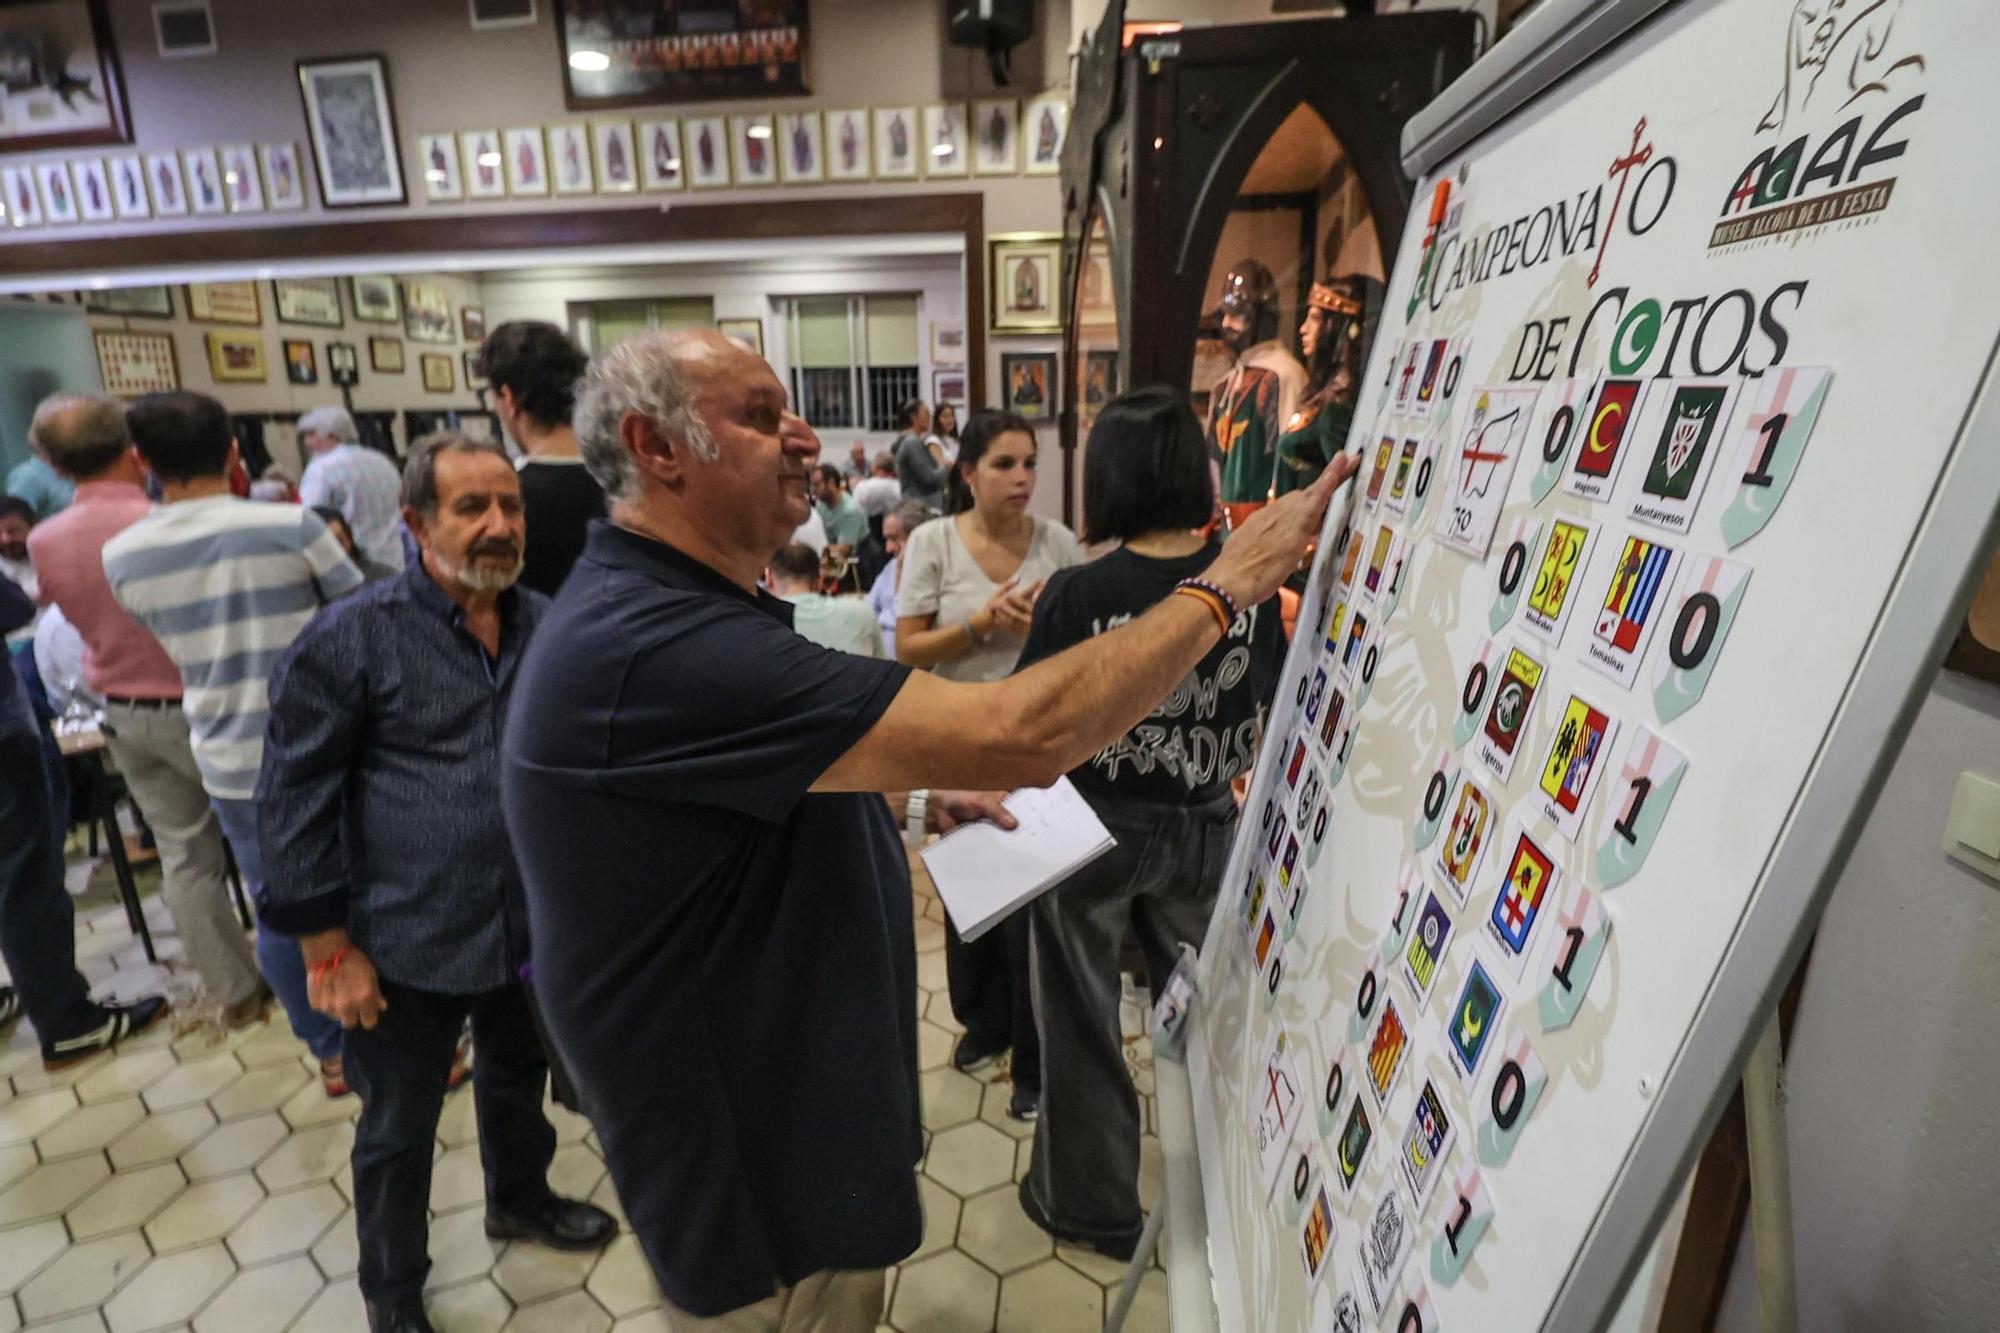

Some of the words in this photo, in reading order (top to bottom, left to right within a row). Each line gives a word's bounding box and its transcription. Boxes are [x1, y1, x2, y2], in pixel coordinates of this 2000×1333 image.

[1430, 117, 1676, 312] CAMPEONATO
[1796, 201, 1816, 225] DE
[1816, 198, 1838, 222] LA
[1839, 186, 1889, 218] FESTA
[1509, 316, 1570, 381] DE
[1442, 355, 1462, 399] 0
[1543, 404, 1575, 464] 0
[1741, 413, 1788, 488] 1
[1415, 456, 1432, 498] 0
[1573, 481, 1601, 496] Magenta
[1632, 504, 1685, 526] Muntanyesos
[1388, 559, 1403, 595] 1
[1499, 541, 1527, 597] 0
[1669, 591, 1721, 671] 0
[1362, 644, 1378, 685] 0
[1589, 643, 1625, 673] Tomasinas
[1462, 661, 1488, 716] 0
[1336, 729, 1350, 765] 1
[1423, 770, 1447, 823] 0
[1613, 776, 1652, 846] 1
[1313, 806, 1327, 846] 0
[1391, 890, 1410, 936] 1
[1268, 957, 1281, 995] 0
[1552, 926, 1585, 993] 1
[1357, 970, 1377, 1020] 0
[1325, 1063, 1343, 1112] 0
[1491, 1060, 1526, 1132] 0
[1294, 1154, 1310, 1202] 0
[1445, 1194, 1472, 1258] 1
